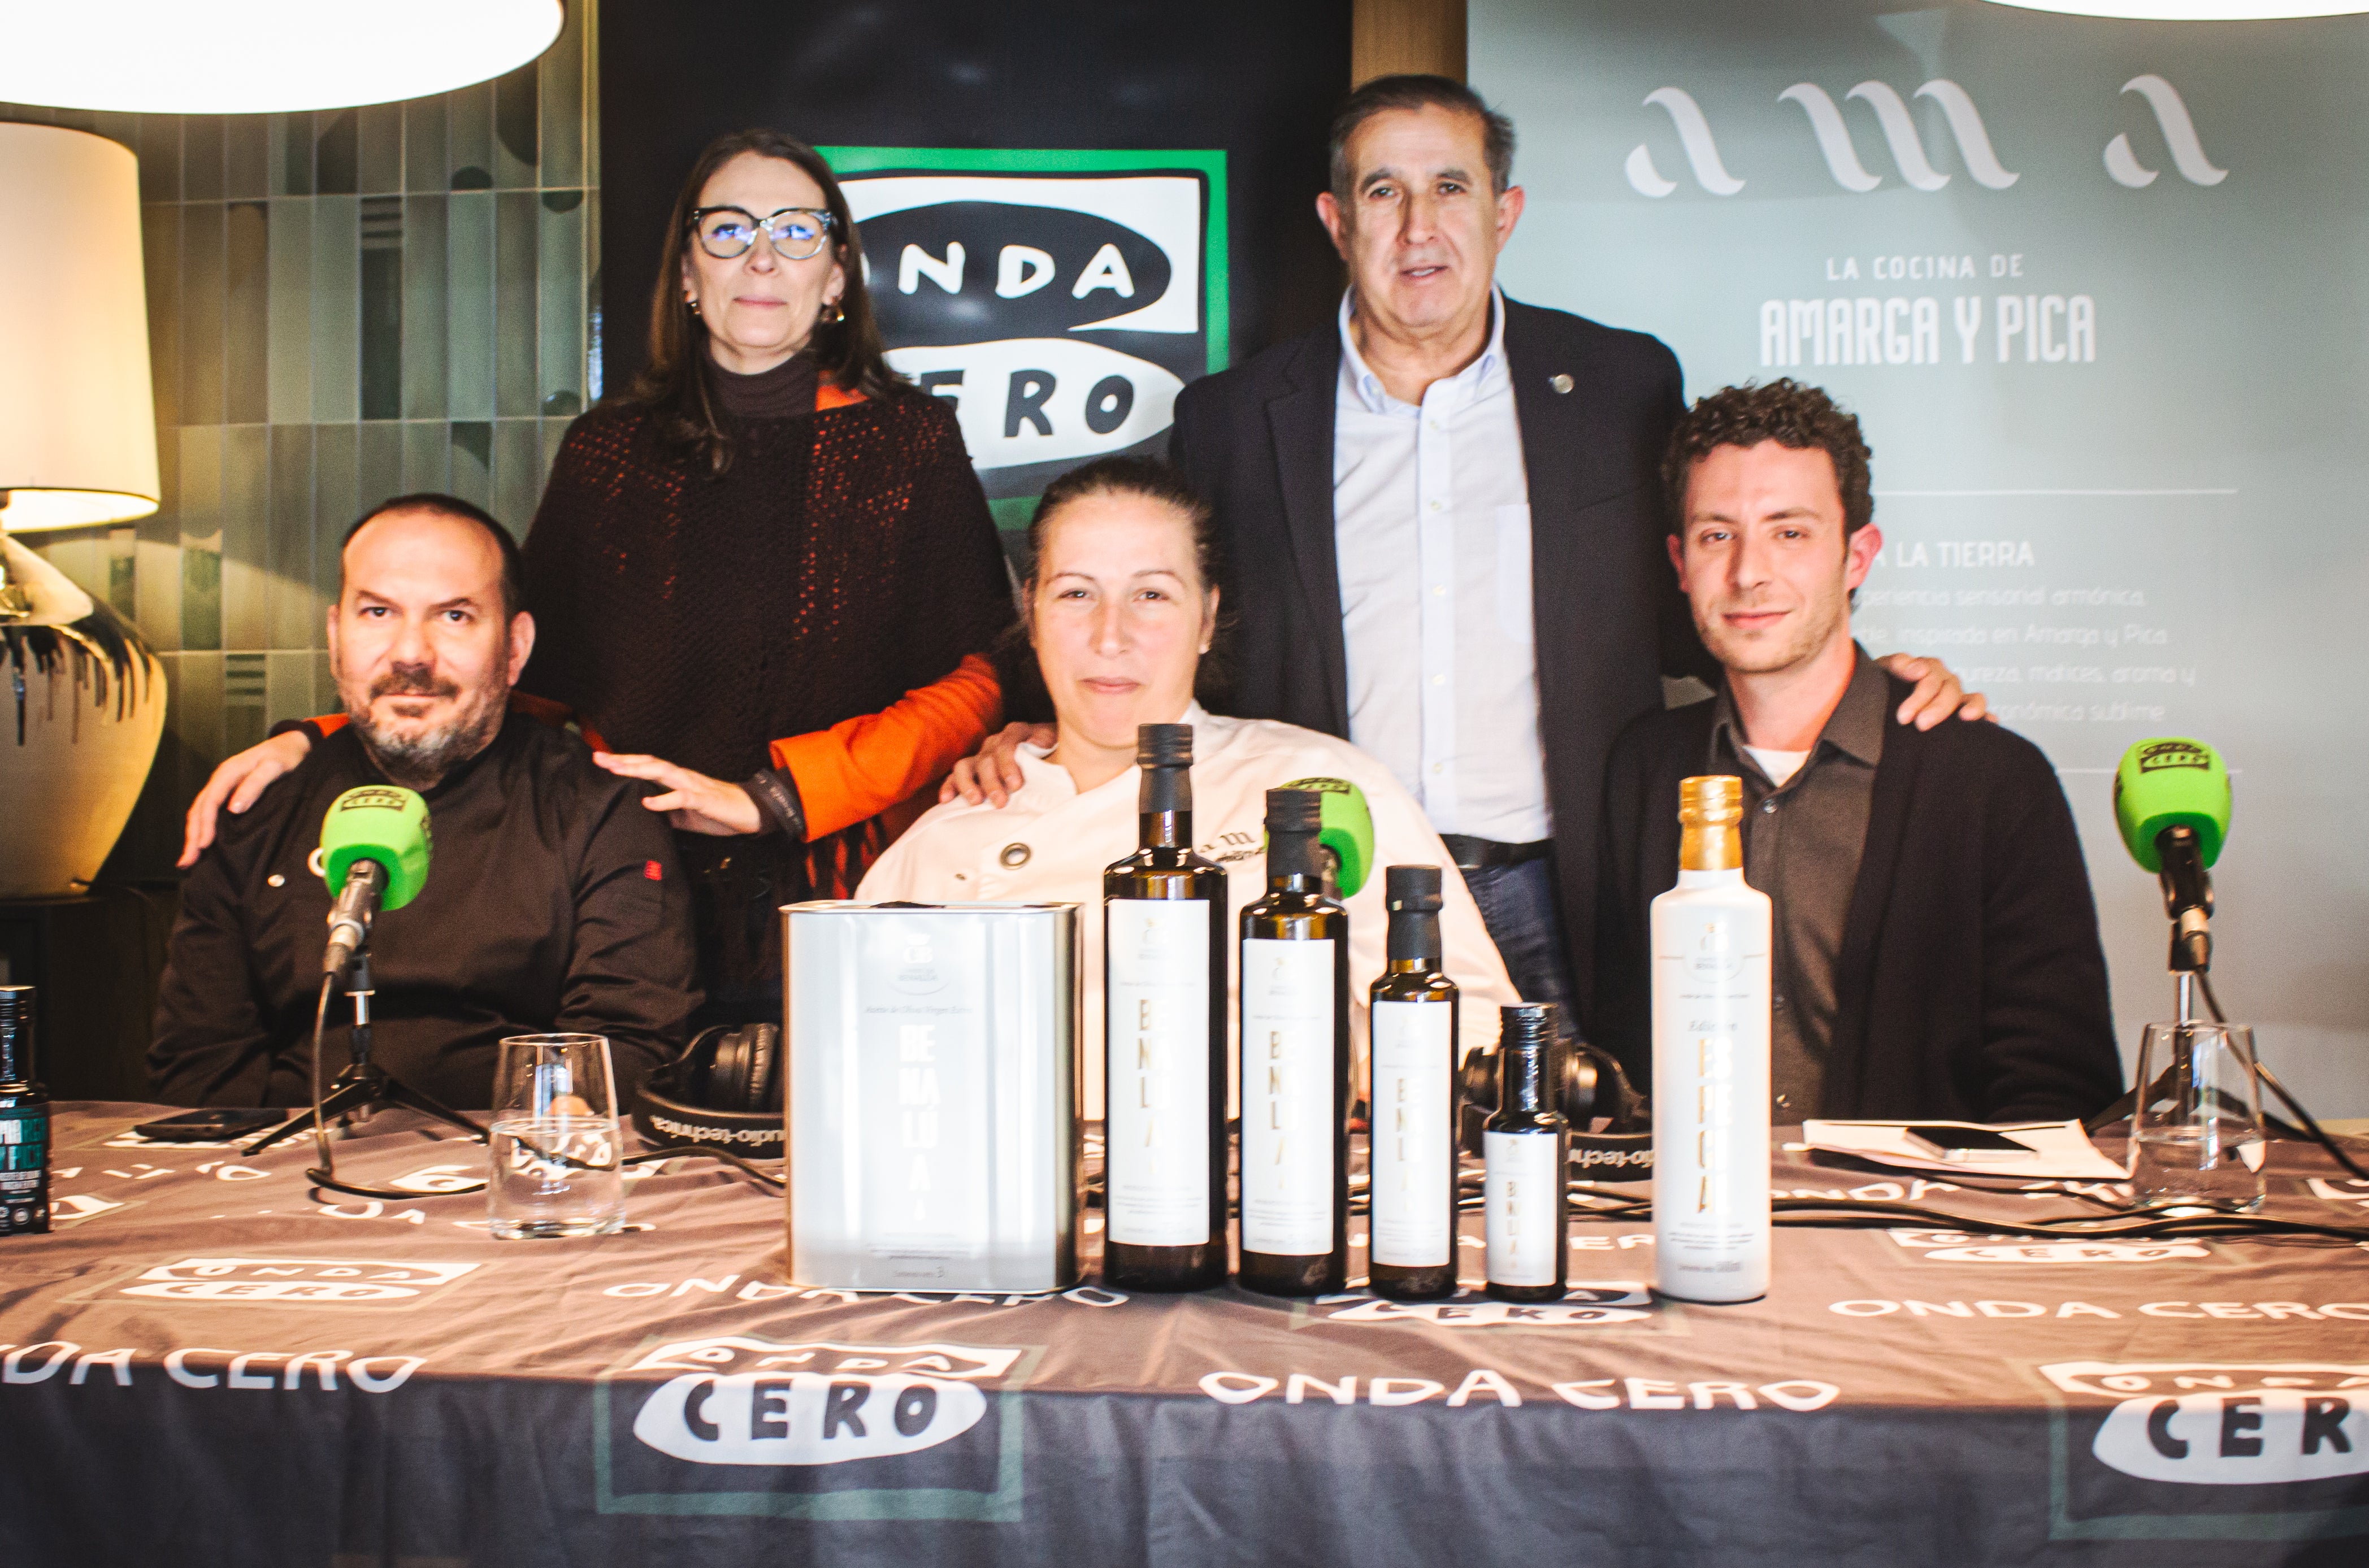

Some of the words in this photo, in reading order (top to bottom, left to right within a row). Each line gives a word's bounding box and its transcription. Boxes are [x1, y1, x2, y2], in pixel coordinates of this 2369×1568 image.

[861, 242, 1135, 299] NDA
[1827, 256, 1859, 281] LA
[1872, 255, 1976, 280] COCINA
[1990, 253, 2024, 278] DE
[1759, 297, 1939, 366] AMARGA
[1954, 296, 1981, 364] Y
[1997, 294, 2095, 363] PICA
[919, 369, 1135, 438] ERO
[1896, 541, 1929, 568] LA
[1937, 541, 2036, 568] TIERRA
[2103, 628, 2119, 648] y
[650, 1115, 785, 1147] udio-technica
[192, 1265, 411, 1280] ONDA
[164, 1284, 385, 1297] CERO
[1829, 1300, 2122, 1319] ONDA
[2138, 1301, 2369, 1321] CERO
[0, 1341, 137, 1386] DA
[163, 1348, 428, 1393] CERO
[690, 1347, 951, 1371] ONDA
[1199, 1369, 1522, 1407] ONDA
[1552, 1376, 1841, 1411] CERO
[684, 1378, 939, 1442] CERO
[2147, 1396, 2353, 1459] CER
